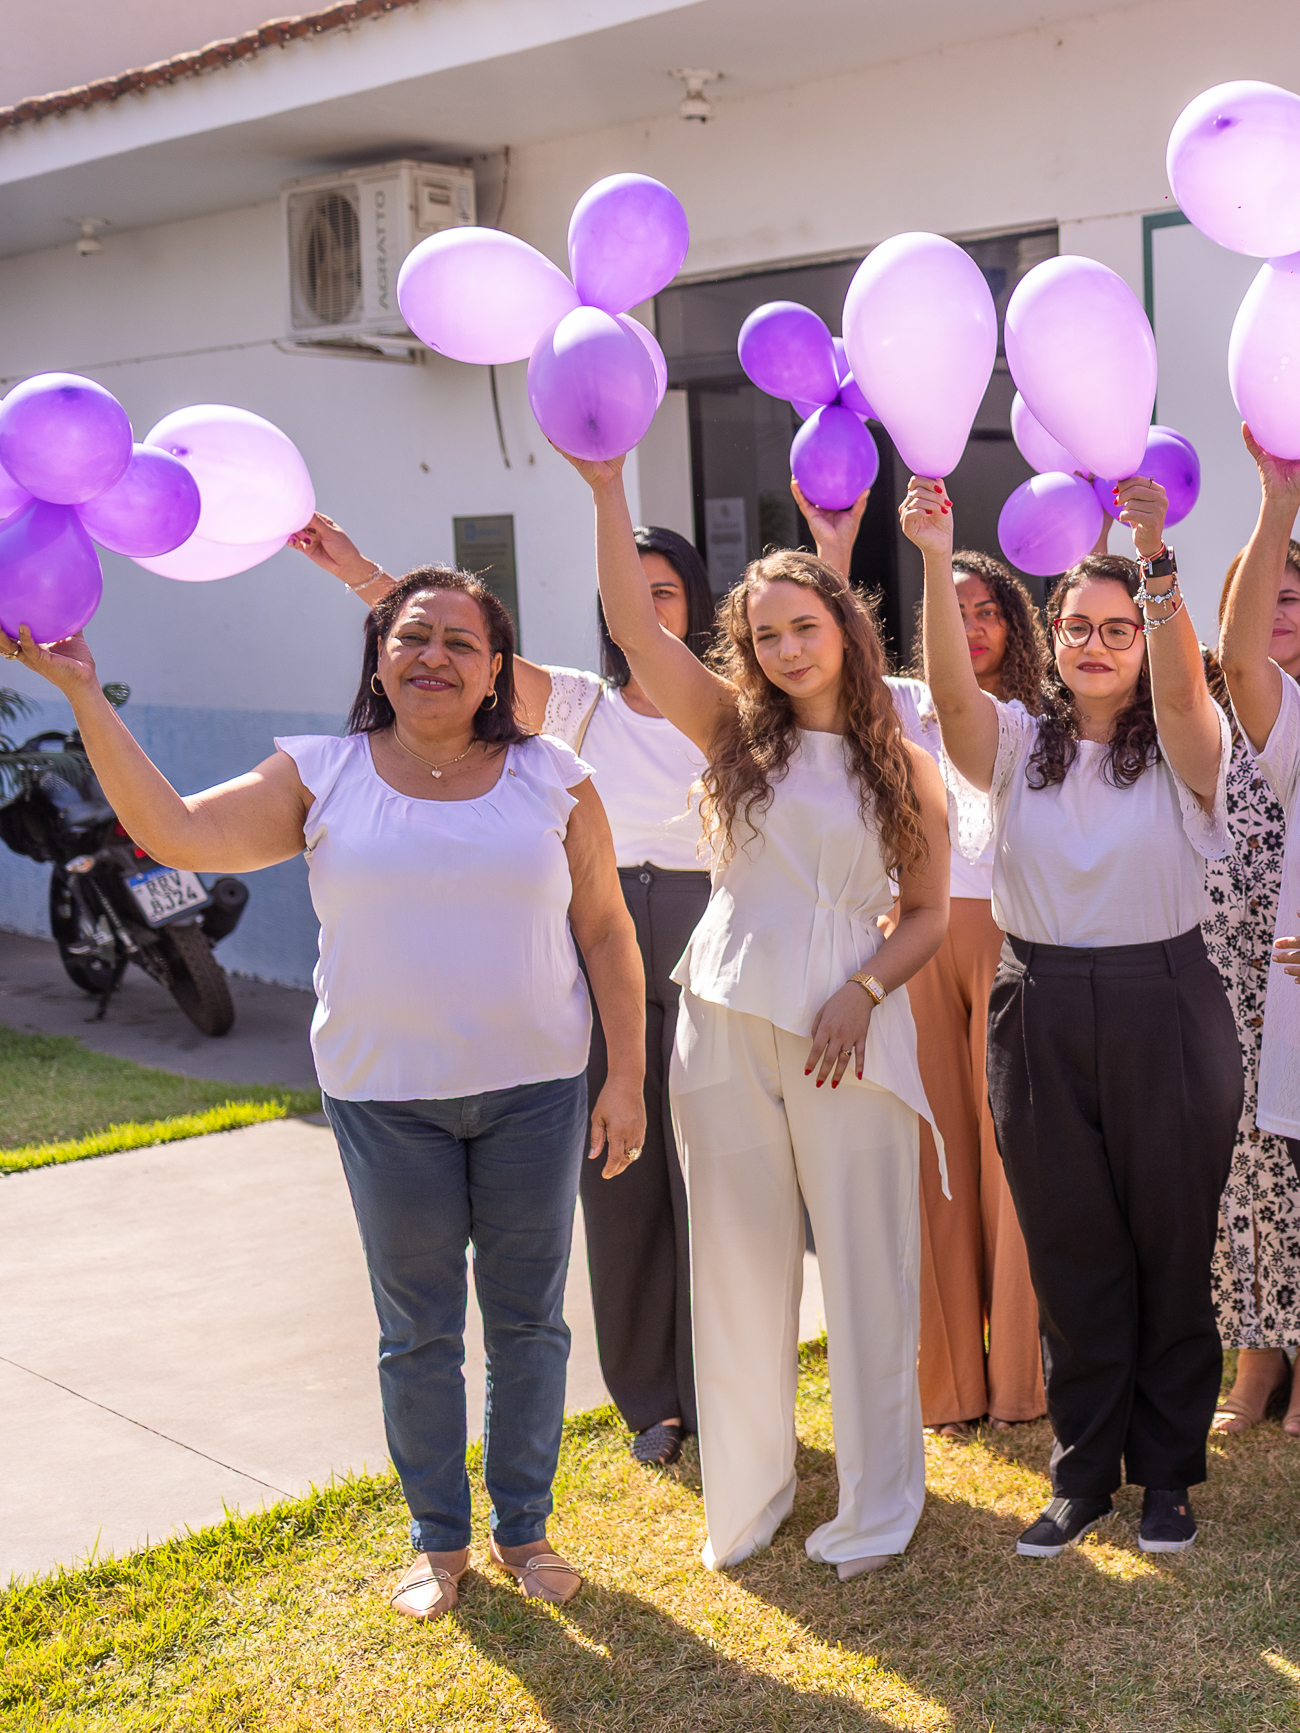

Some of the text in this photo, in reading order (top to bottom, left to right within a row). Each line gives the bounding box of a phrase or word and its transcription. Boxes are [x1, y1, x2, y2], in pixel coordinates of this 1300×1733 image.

[375, 190, 389, 310] AGRATTO
[146, 872, 181, 897] RRV
[150, 885, 198, 914] BJ24
